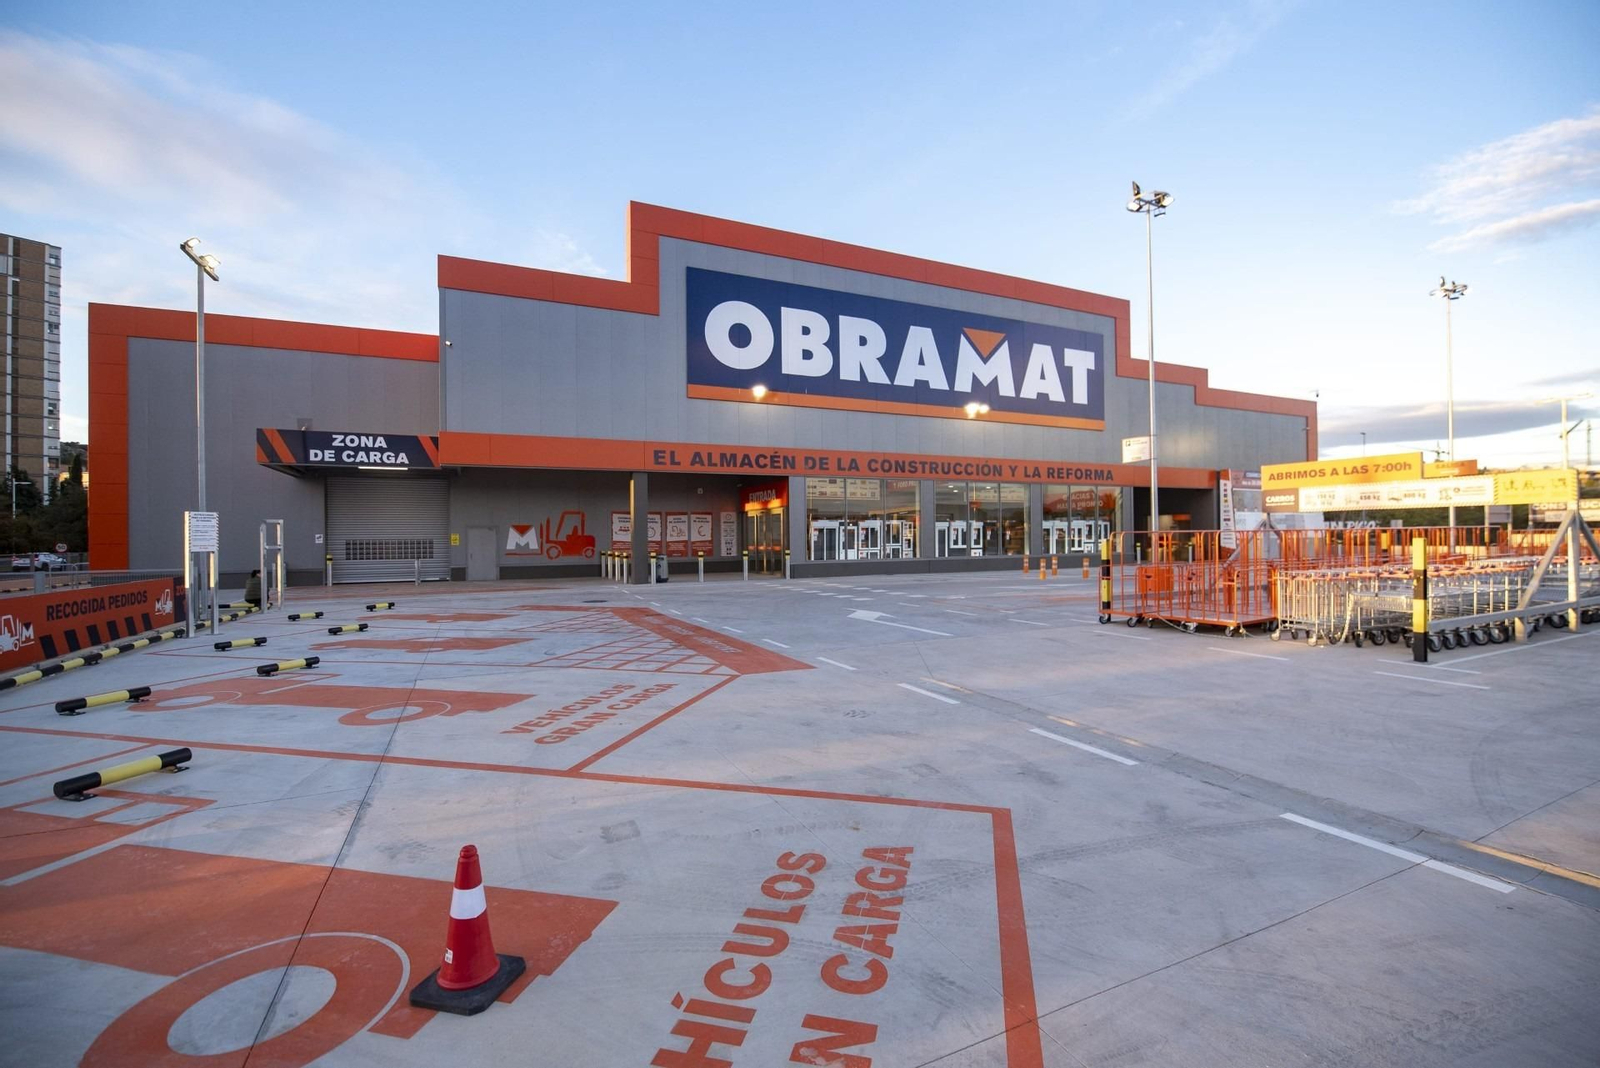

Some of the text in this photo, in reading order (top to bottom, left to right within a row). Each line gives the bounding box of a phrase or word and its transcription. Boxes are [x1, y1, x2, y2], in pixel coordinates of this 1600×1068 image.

[704, 300, 1095, 405] OBRAMAT
[309, 449, 410, 464] DE CARGA
[332, 434, 388, 448] ZONA
[653, 449, 1114, 481] EL ALMACÉN DE LA CONSTRUCCIÓN Y LA REFORMA
[1268, 468, 1326, 481] ABRIMOS
[1330, 467, 1339, 477] A
[1343, 464, 1369, 475] LAS
[1373, 462, 1412, 473] 7:00h
[749, 489, 776, 503] ENTRADA
[46, 590, 148, 622] RECOGIDA PEDIDOS
[500, 683, 636, 735] VEHÍCULOS
[534, 683, 680, 745] GRAN CARGA
[821, 846, 914, 995] CARGA
